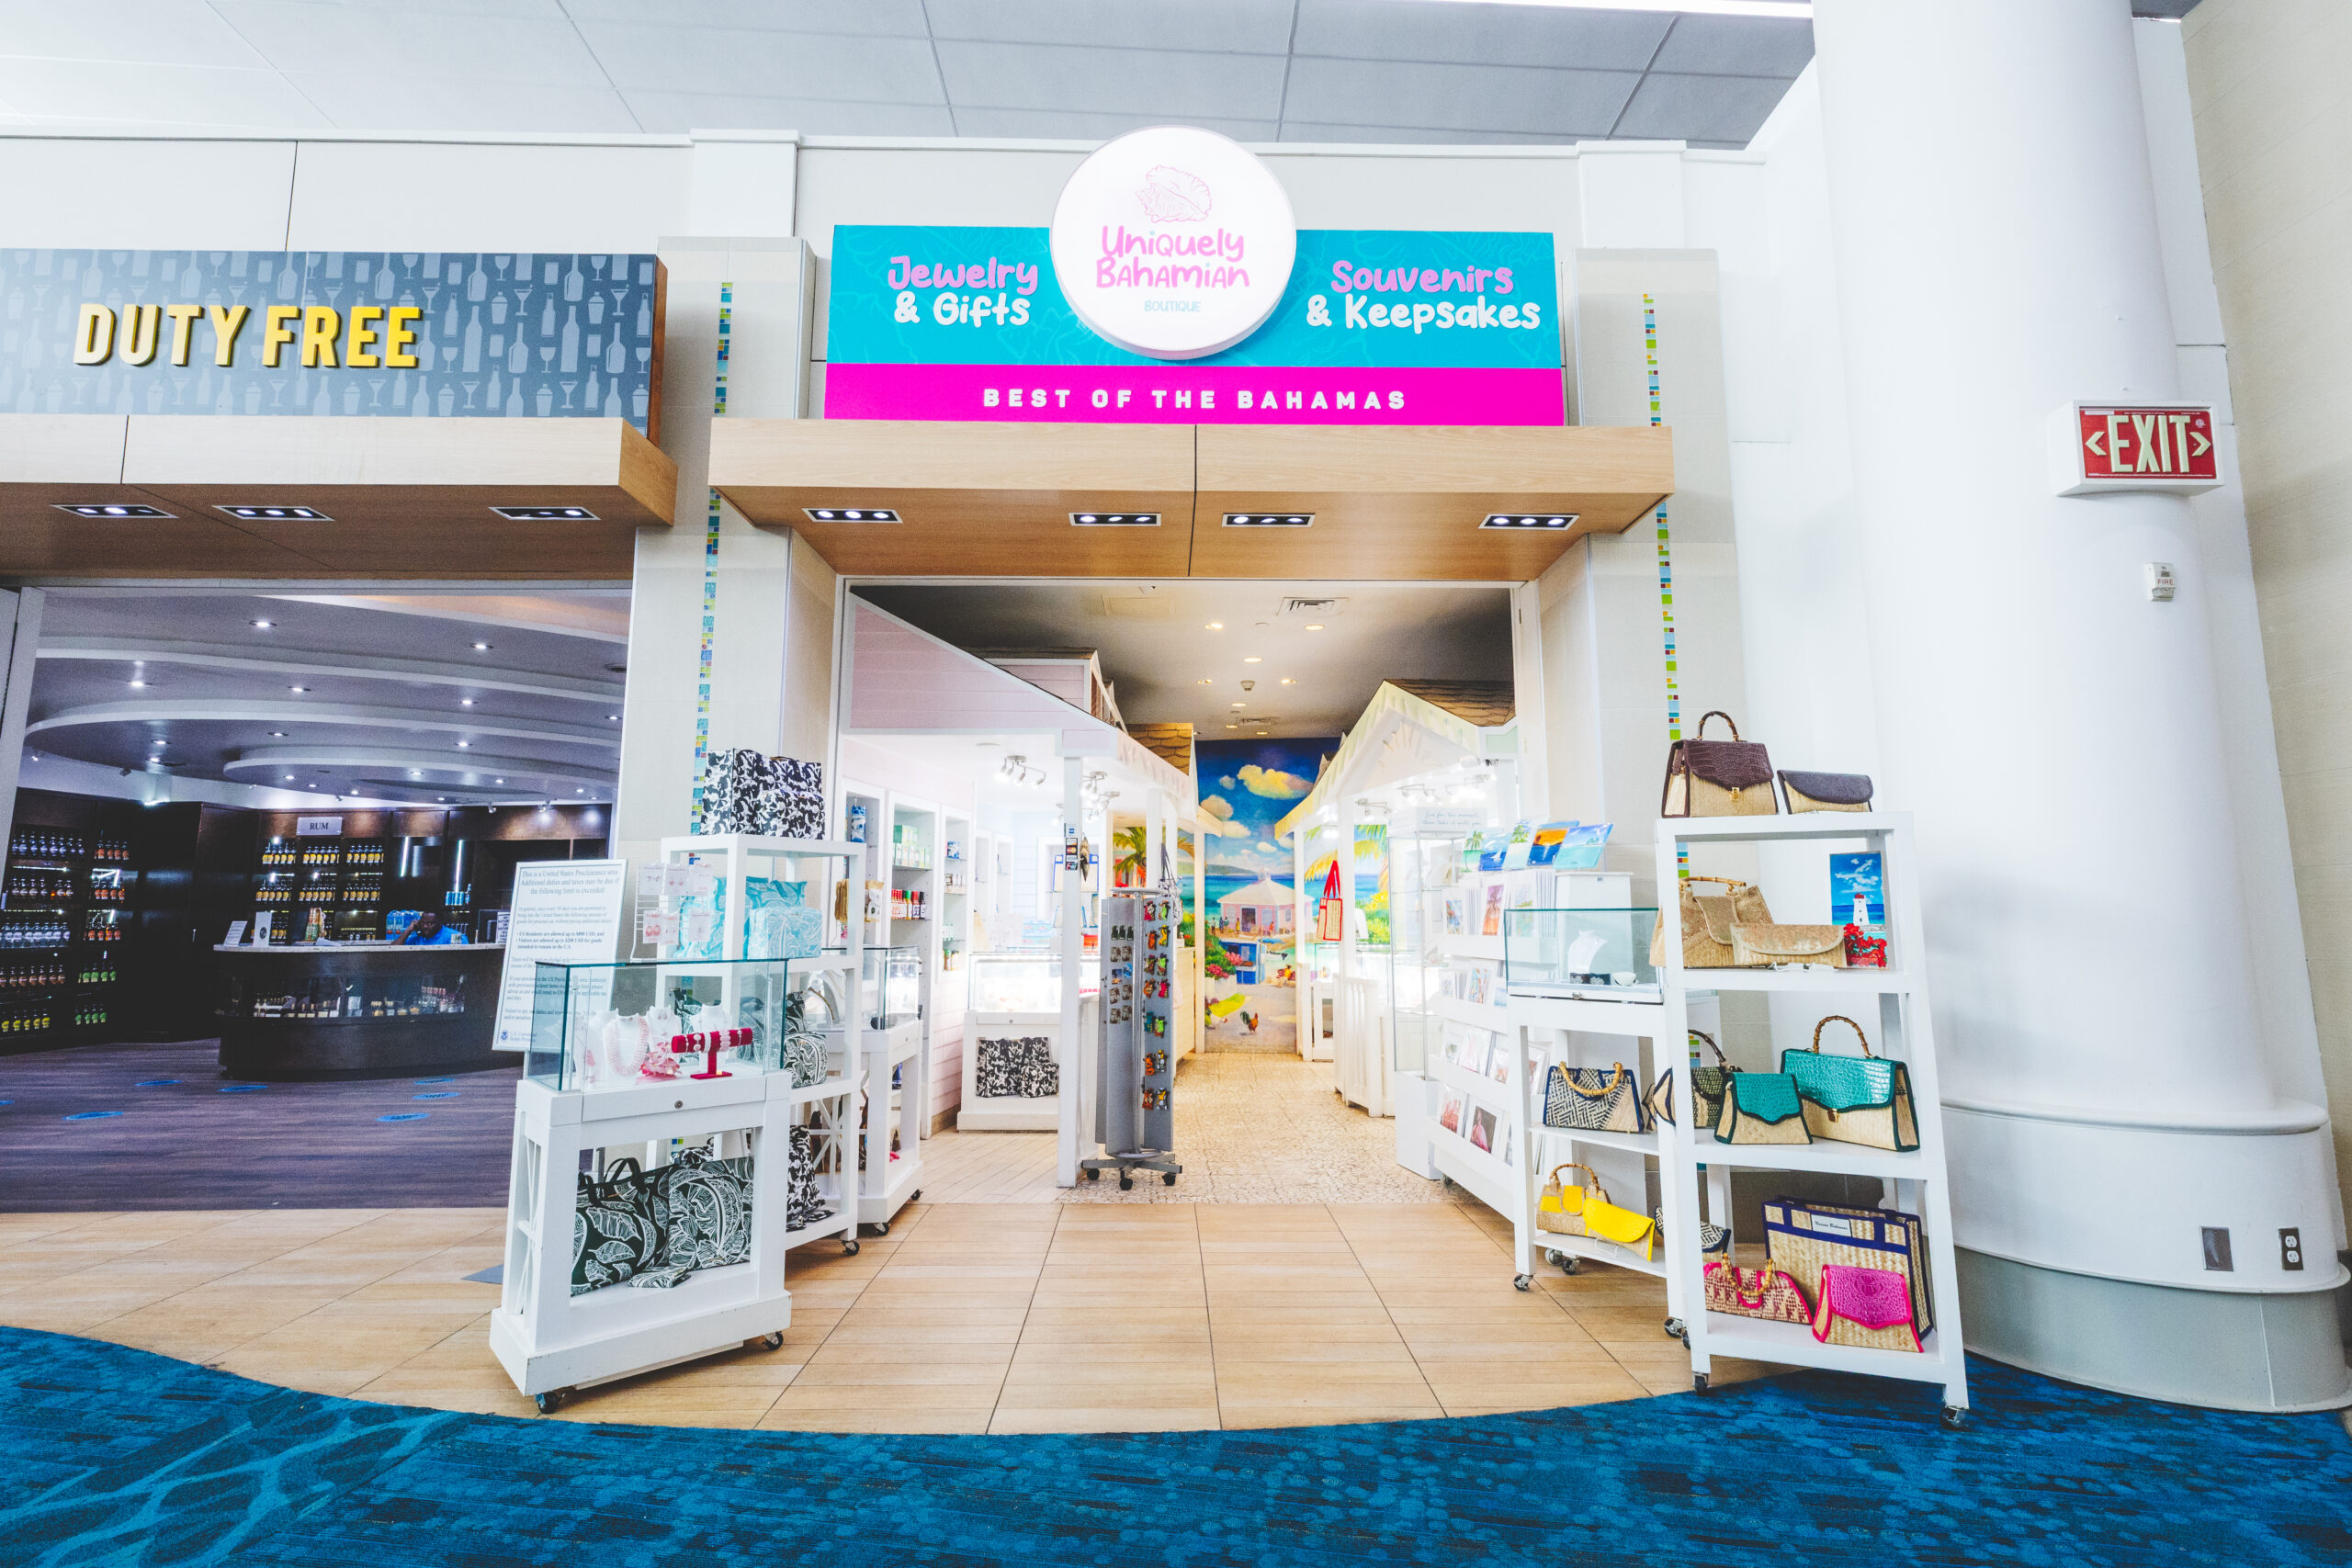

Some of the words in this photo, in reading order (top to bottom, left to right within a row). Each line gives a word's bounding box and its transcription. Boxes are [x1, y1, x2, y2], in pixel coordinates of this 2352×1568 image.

[1100, 226, 1245, 263] Uniquely
[888, 255, 1039, 296] Jewelry
[1096, 256, 1250, 289] Bahamian
[1330, 260, 1514, 295] Souvenirs
[894, 290, 921, 323] &
[933, 292, 1031, 328] Gifts
[1144, 299, 1202, 313] BOUTIQUE
[1306, 294, 1333, 327] &
[1345, 293, 1541, 334] Keepsakes
[74, 303, 248, 367] DUTY
[262, 305, 424, 368] FREE
[983, 388, 1071, 409] BEST
[1091, 389, 1132, 409] OF
[1151, 389, 1216, 410] THE
[1238, 389, 1406, 410] BAHAMAS
[2108, 414, 2191, 473] EXIT
